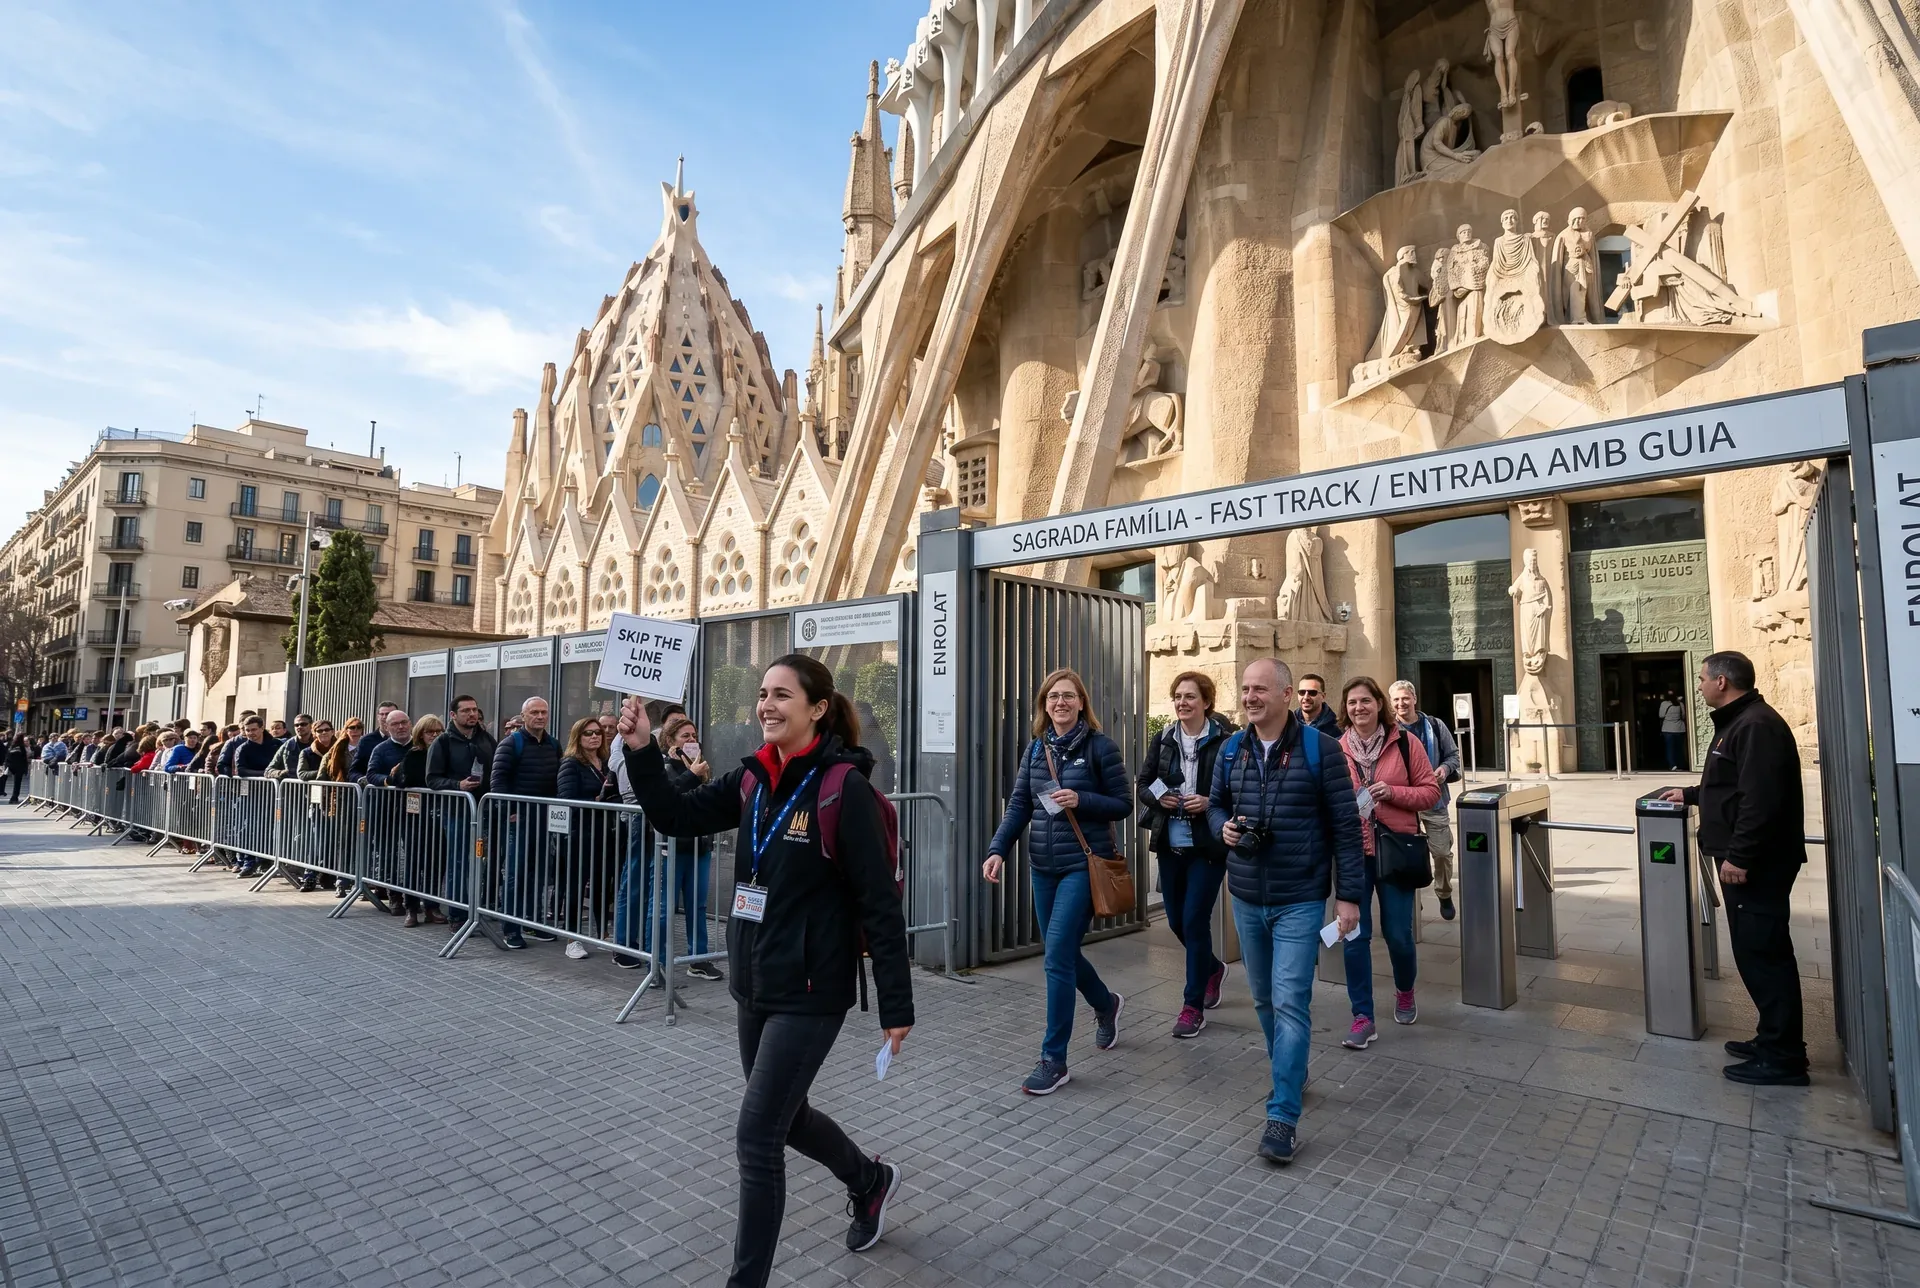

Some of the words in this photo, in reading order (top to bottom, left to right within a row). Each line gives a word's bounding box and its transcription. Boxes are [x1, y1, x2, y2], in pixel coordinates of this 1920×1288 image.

[1012, 522, 1100, 553] SAGRADA
[1105, 508, 1188, 541] FAMÍLIA
[1210, 494, 1267, 525] FAST
[1274, 479, 1362, 515] TRACK
[1369, 474, 1380, 507] /
[1390, 452, 1539, 499] ENTRADA
[1547, 438, 1627, 476] AMB
[1638, 421, 1737, 461] GUIA
[1621, 557, 1637, 568] DE
[1642, 551, 1703, 567] NAZARET
[1613, 571, 1645, 582] DELS
[1651, 565, 1693, 579] JUEUS
[617, 628, 650, 645] SKIP
[654, 634, 683, 652] THE
[933, 590, 947, 676] ENROLAT
[630, 647, 664, 665] LINE
[623, 662, 663, 683] TOUR
